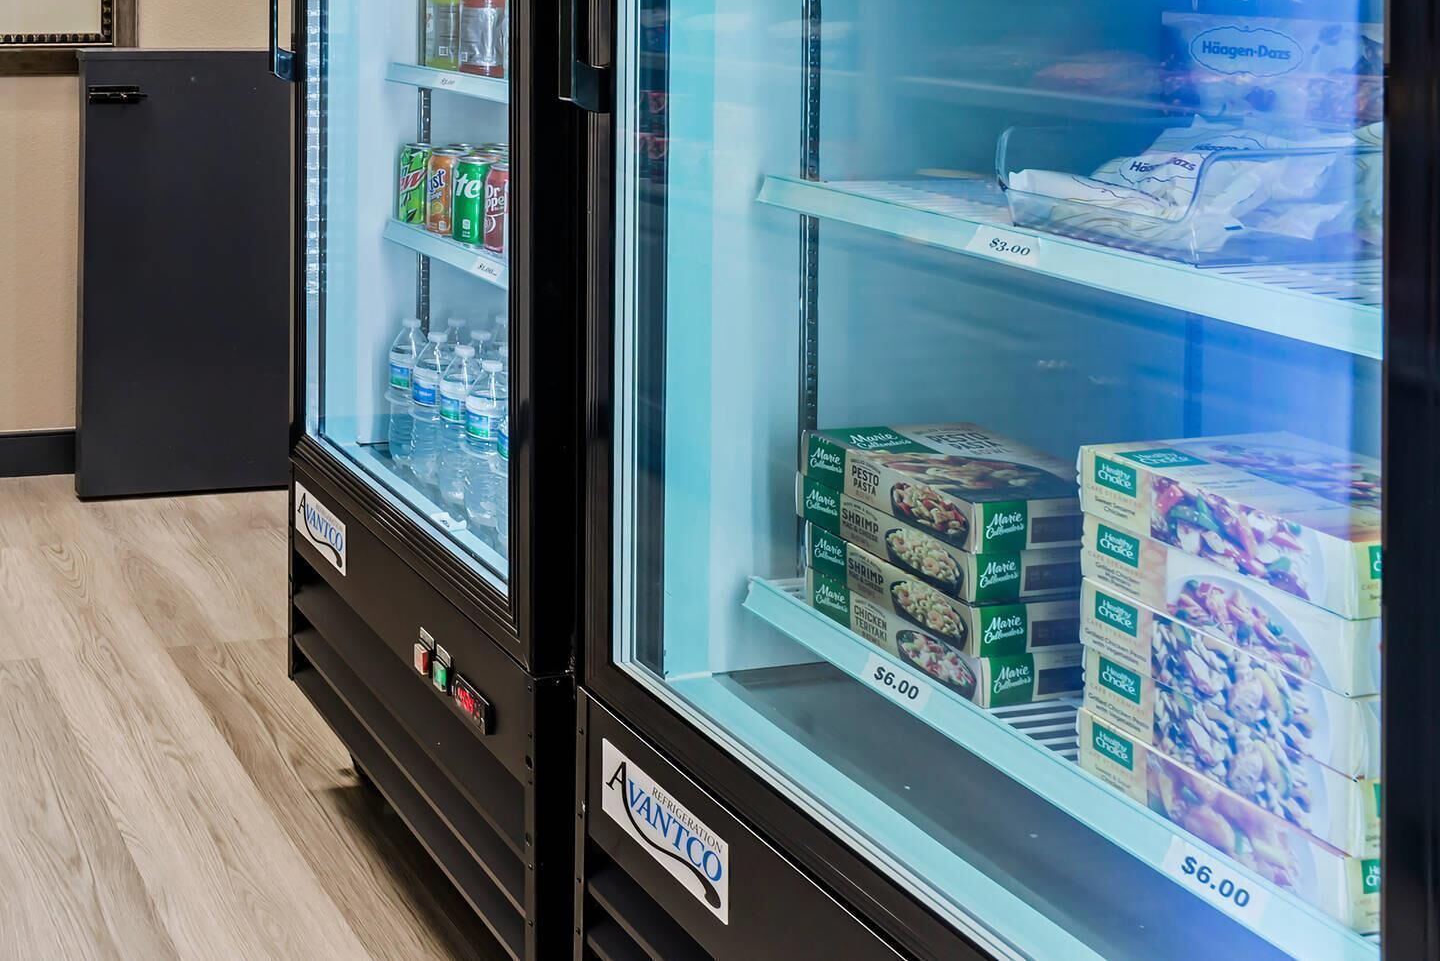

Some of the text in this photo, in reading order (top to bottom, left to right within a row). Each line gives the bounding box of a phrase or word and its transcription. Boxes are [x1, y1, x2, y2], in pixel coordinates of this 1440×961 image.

[989, 237, 1031, 258] $3.00
[813, 448, 842, 466] Marie
[851, 464, 880, 486] PESTO
[1097, 470, 1133, 489] Choice
[1101, 462, 1131, 481] Healthy
[809, 488, 837, 508] Marie
[853, 479, 878, 497] PASTA
[297, 493, 345, 556] AVANTCO
[841, 508, 880, 534] SHRIMP
[991, 511, 1023, 528] Marie
[816, 539, 843, 557] Marie
[1100, 538, 1135, 560] Choice
[1104, 532, 1134, 551] Healthy
[848, 560, 885, 586] SHRIMP
[985, 560, 1017, 577] Marie
[817, 584, 846, 603] Marie
[854, 605, 888, 631] CHICKEN
[1098, 605, 1133, 628] Choice
[1103, 599, 1131, 619] Healthy
[855, 616, 888, 642] TERIYAKI
[990, 615, 1022, 632] Marie
[873, 665, 920, 701] $6.00
[999, 664, 1030, 681] Marie
[1102, 671, 1137, 695] Choice
[1107, 666, 1134, 686] Healthy
[1095, 737, 1129, 762] Choice
[1100, 731, 1127, 752] Healthy
[605, 760, 723, 888] AVANTCO
[651, 786, 724, 855] REFRIGERATION
[1180, 855, 1251, 908] $6.00
